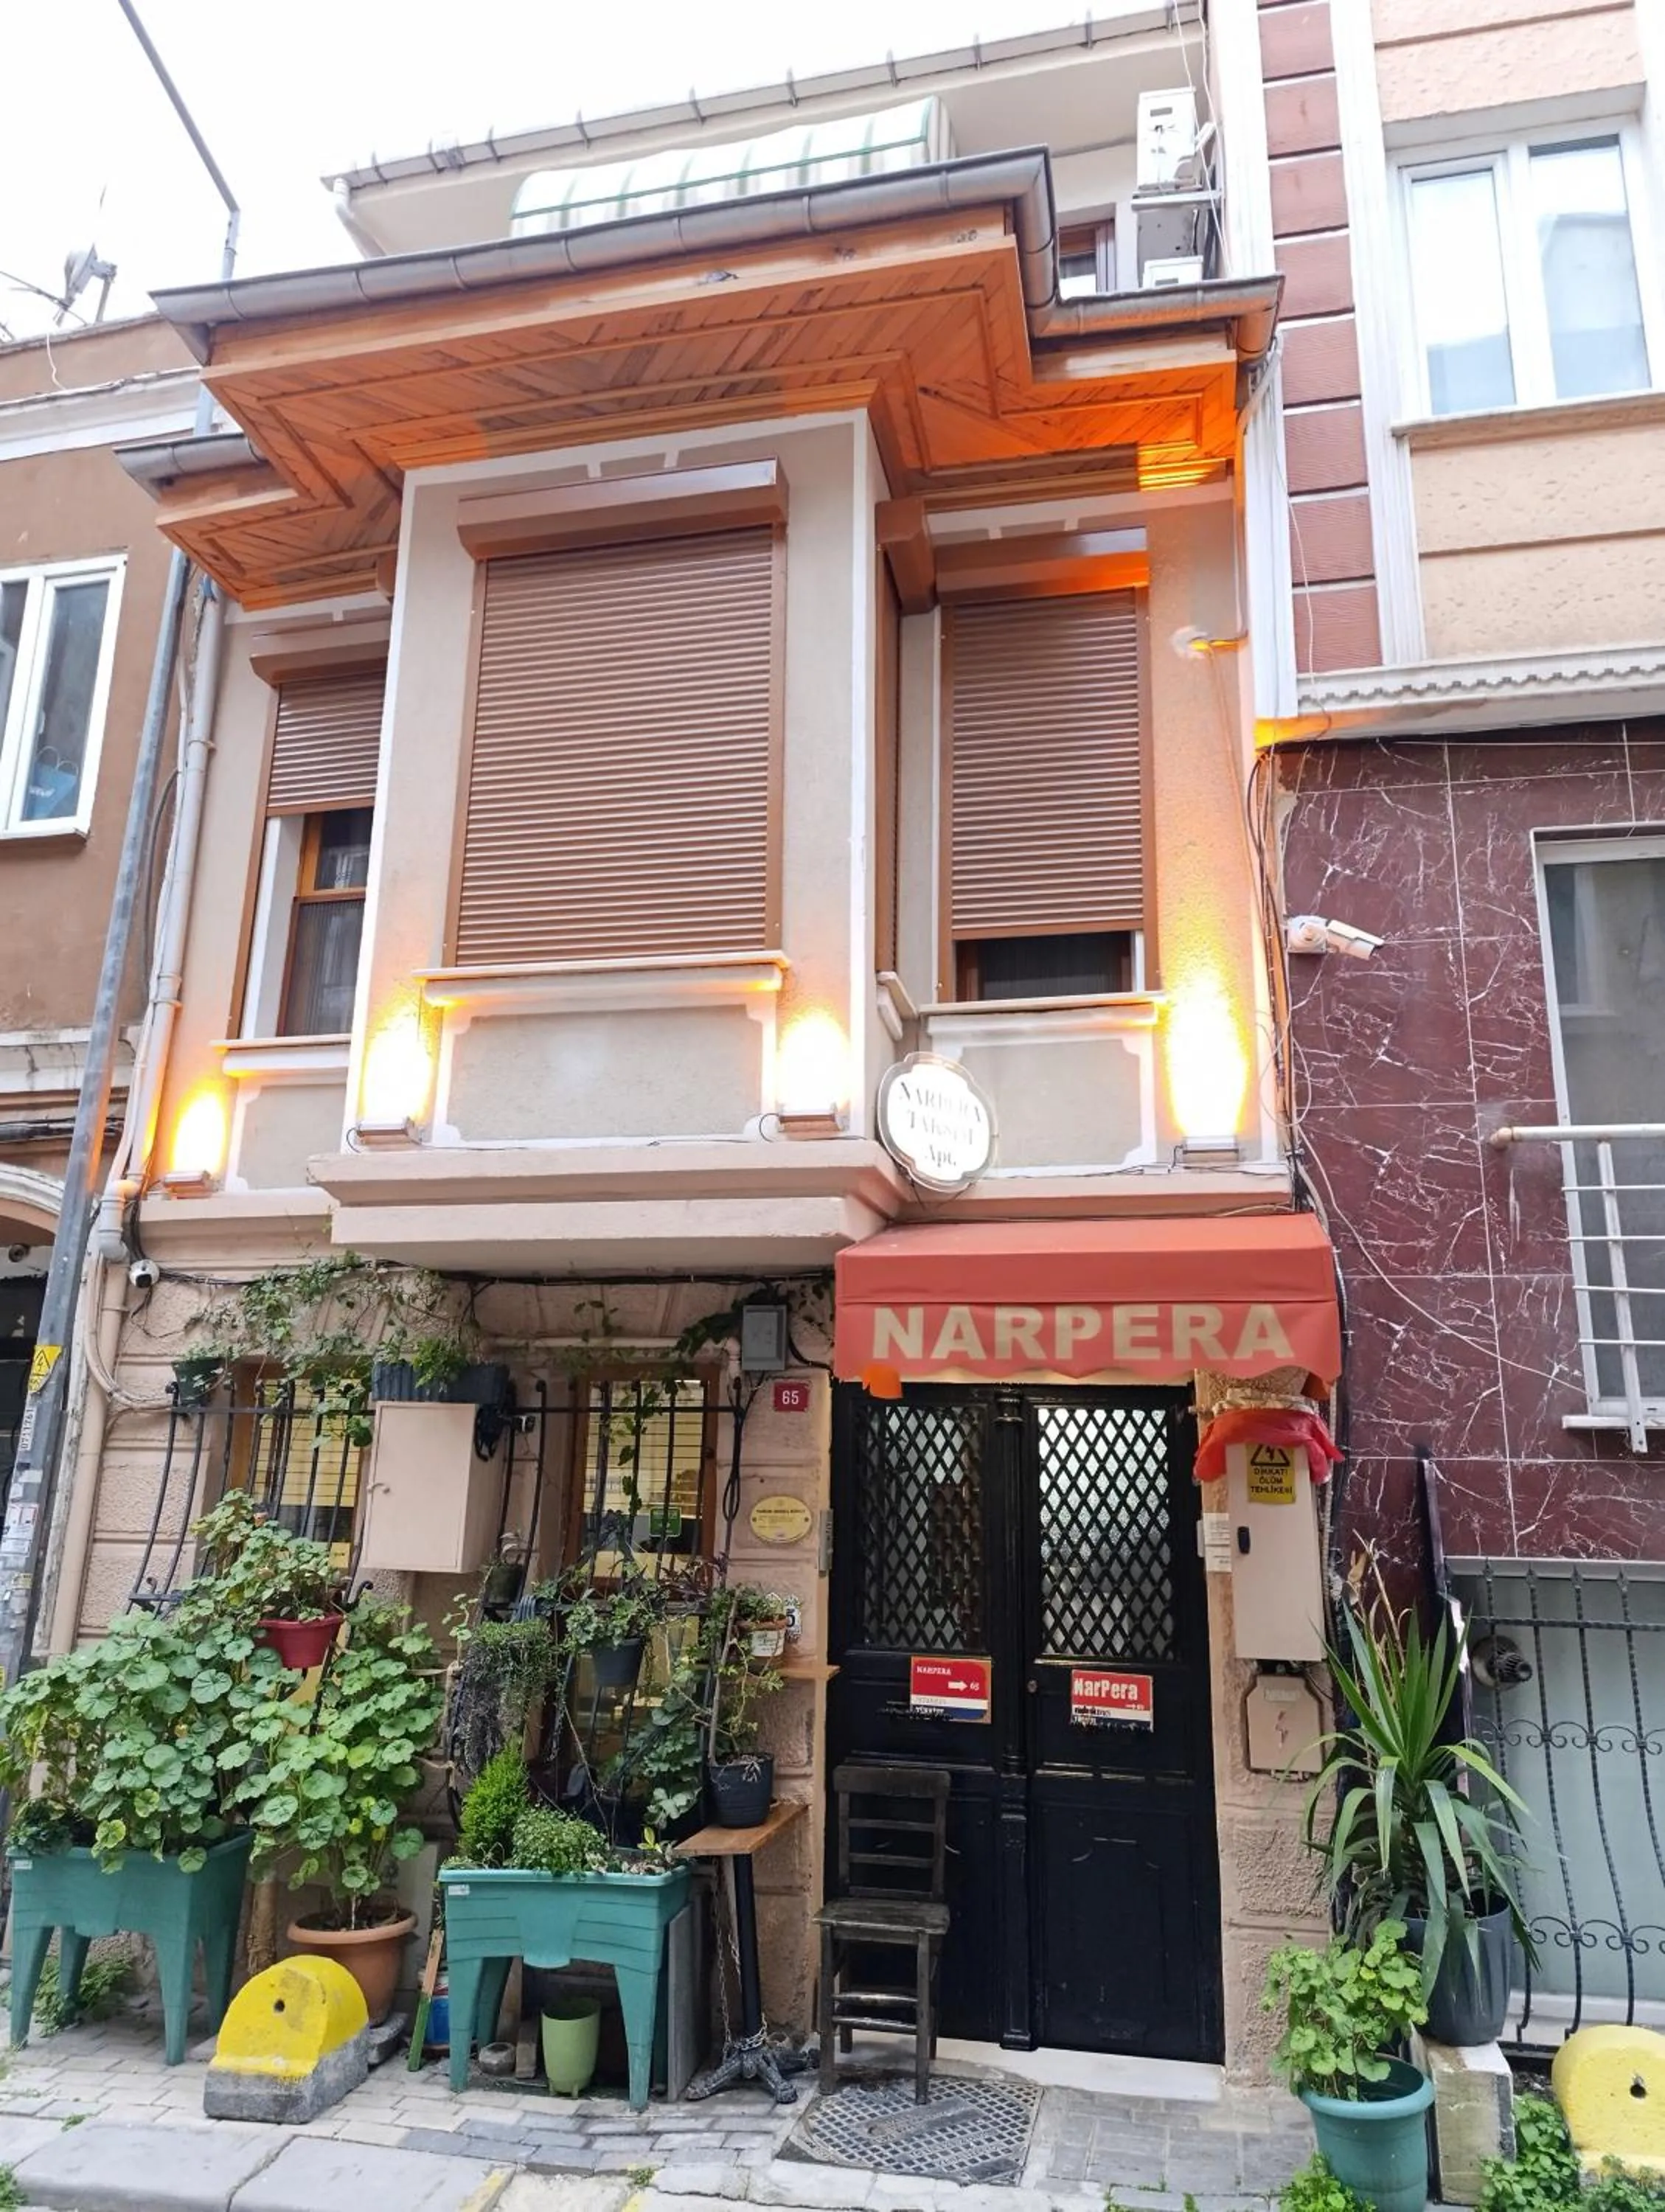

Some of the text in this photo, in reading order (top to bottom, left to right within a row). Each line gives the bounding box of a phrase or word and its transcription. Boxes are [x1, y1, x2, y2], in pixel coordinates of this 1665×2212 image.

[872, 1303, 1296, 1360] NARPERA
[782, 1390, 799, 1405] 65
[1074, 1677, 1138, 1701] NarPera
